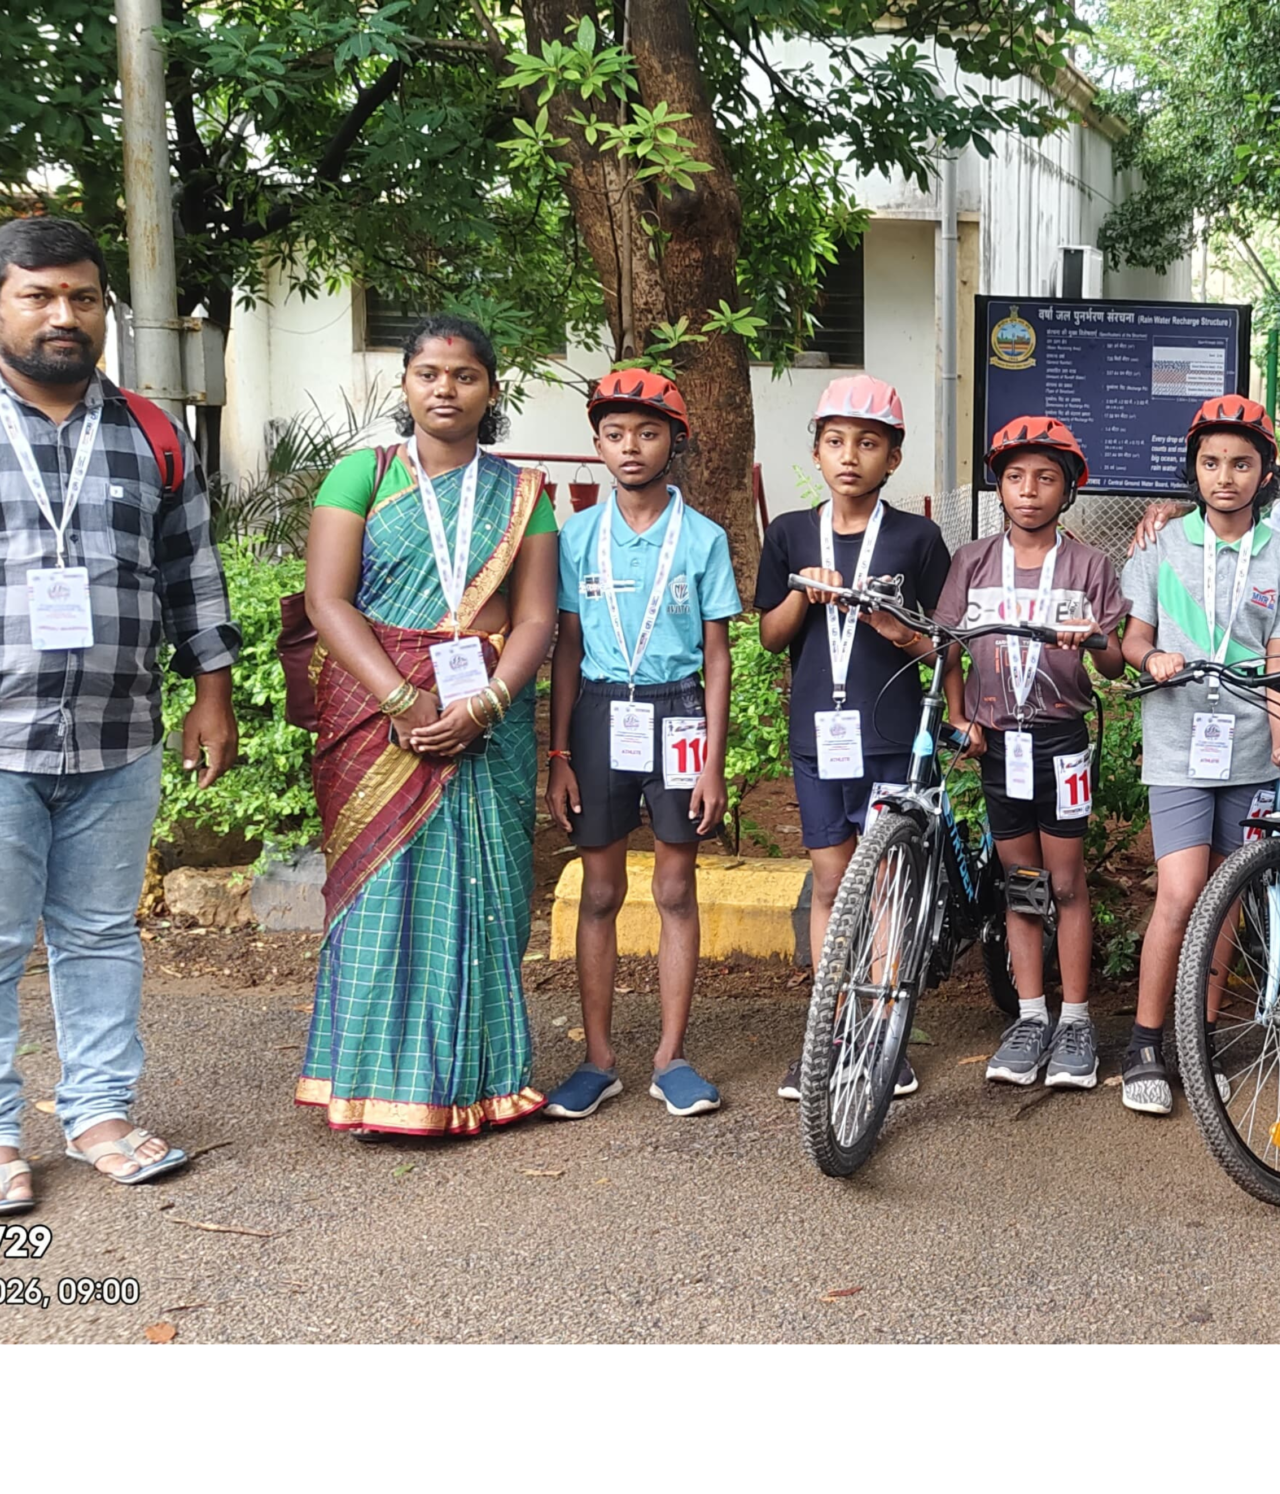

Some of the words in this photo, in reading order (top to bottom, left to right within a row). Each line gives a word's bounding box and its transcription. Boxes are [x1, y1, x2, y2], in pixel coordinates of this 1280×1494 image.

[1038, 306, 1053, 321] वर्षा
[1056, 309, 1071, 321] जल
[1073, 308, 1104, 326] पुनर्भरण
[1106, 309, 1135, 323] संरचना
[1137, 317, 1153, 325] (Rain
[1154, 317, 1171, 325] Water
[1172, 317, 1200, 327] Recharge
[1151, 434, 1166, 444] Every
[1166, 436, 1178, 444] drop
[1151, 453, 1160, 463] big
